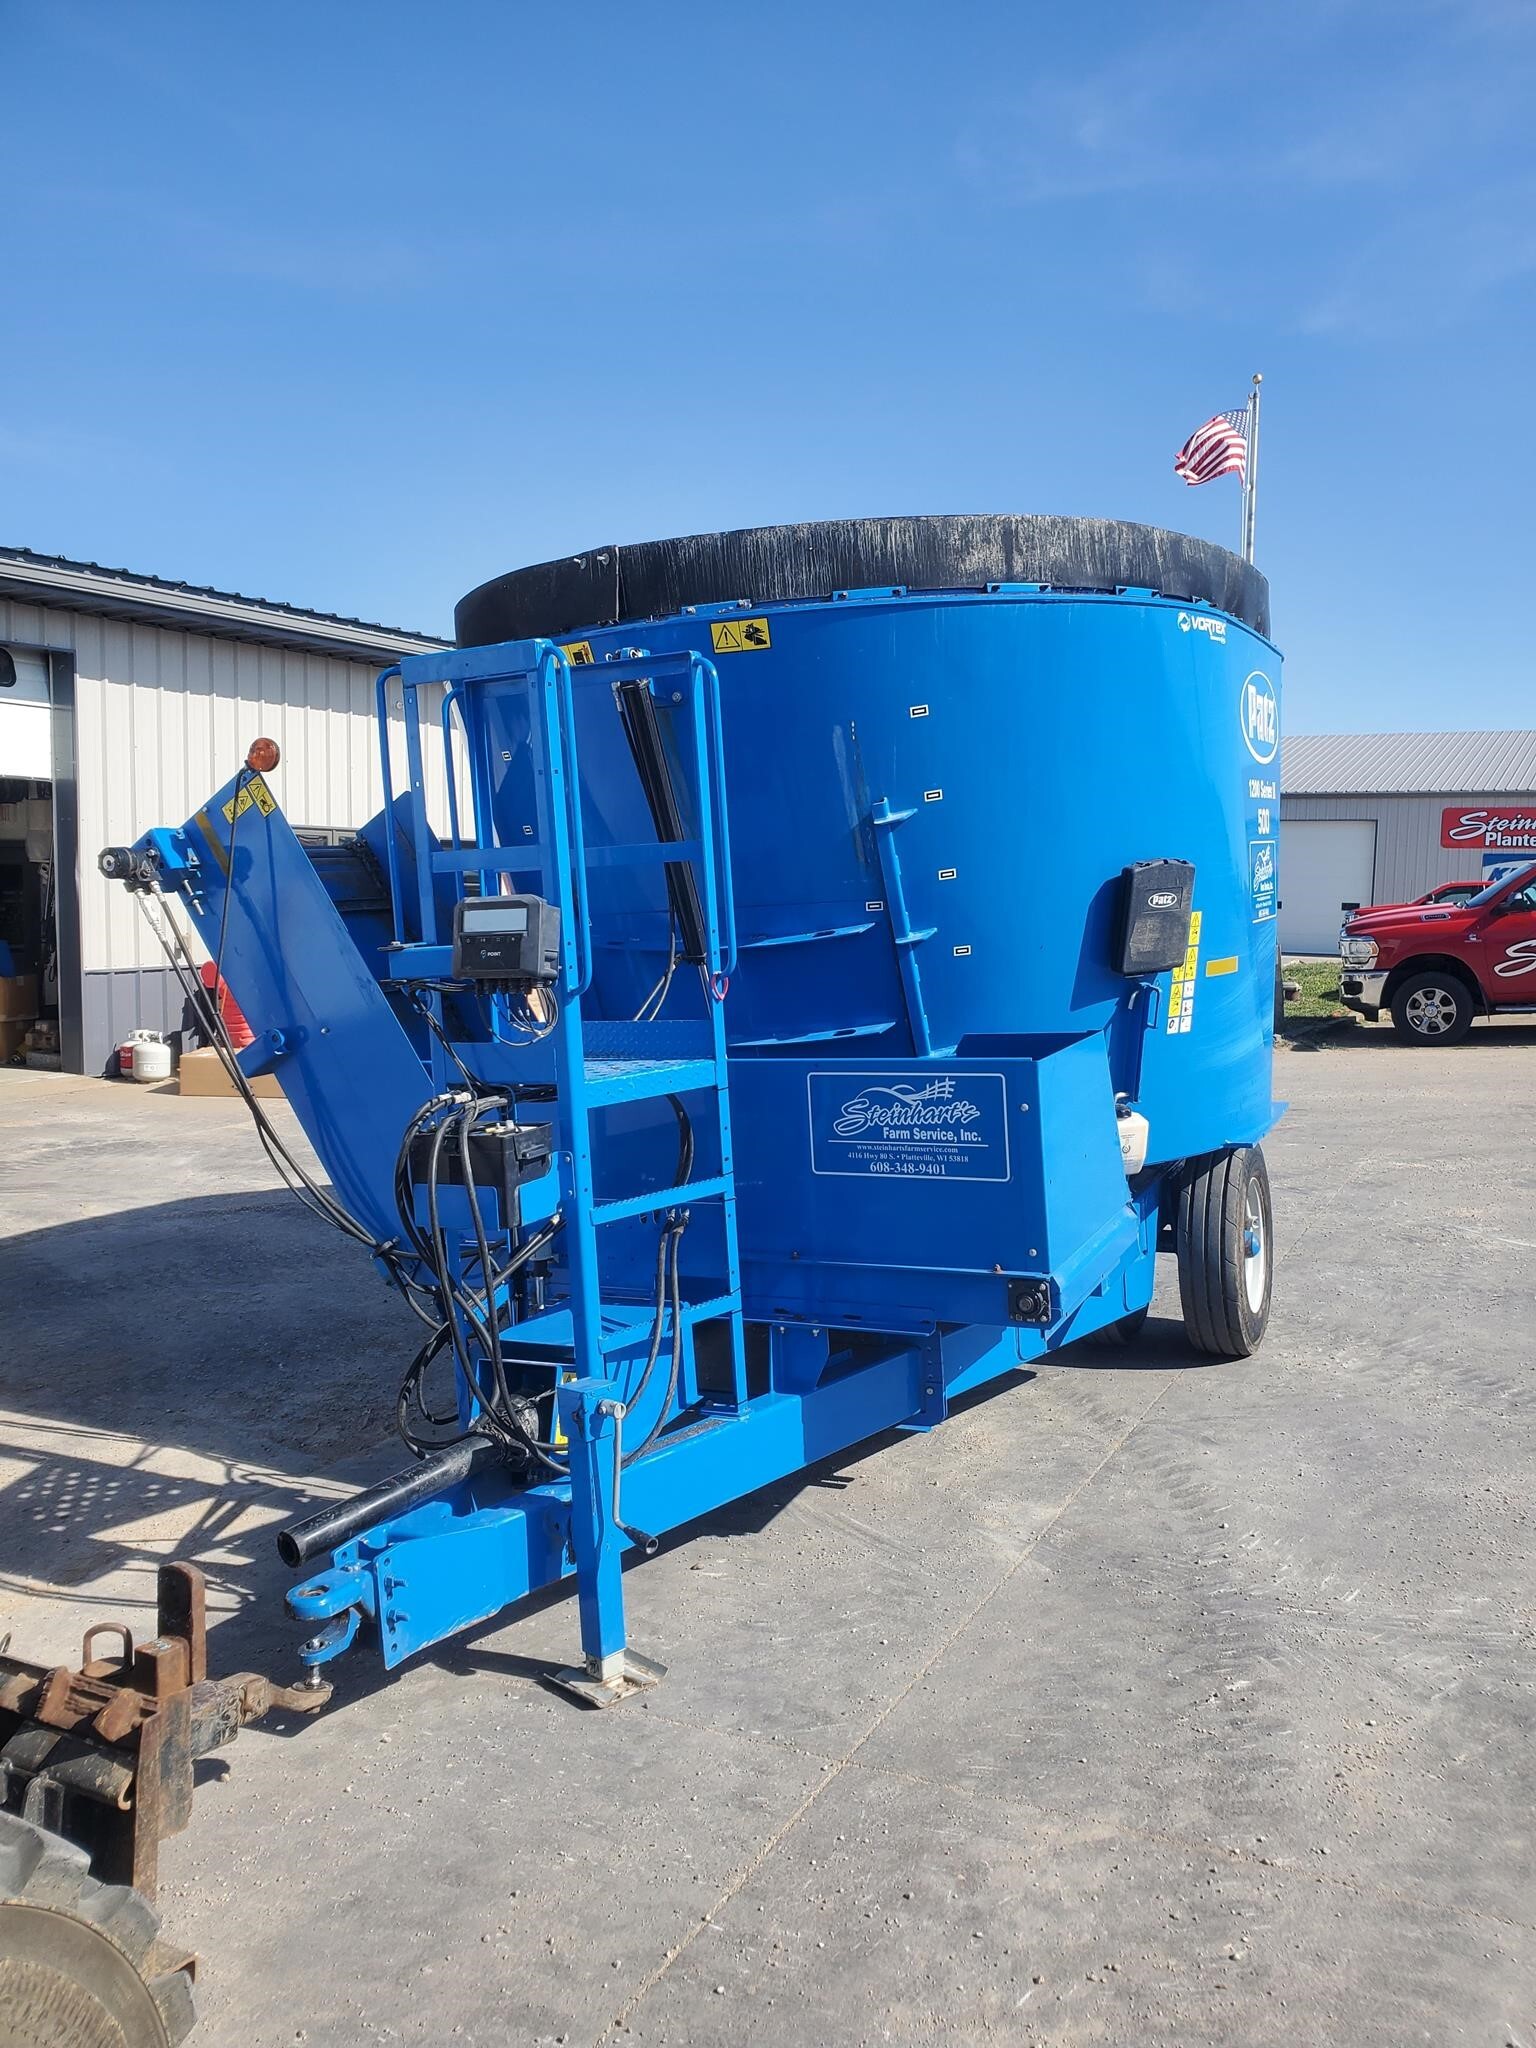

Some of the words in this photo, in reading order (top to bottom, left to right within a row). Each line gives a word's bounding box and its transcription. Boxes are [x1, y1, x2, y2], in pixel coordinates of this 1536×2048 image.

[1191, 616, 1226, 636] VORTEX
[1247, 684, 1275, 744] Patz
[1257, 808, 1270, 835] 500
[1449, 811, 1536, 840] Stein
[1485, 832, 1536, 847] Plante
[1152, 895, 1173, 905] Patz
[833, 1098, 981, 1136] Steinhart's
[883, 1127, 911, 1140] Farm
[913, 1128, 957, 1143] Service,
[960, 1129, 982, 1142] Inc.
[856, 1144, 958, 1154] www.steinhartsfarmservice.com
[864, 1152, 878, 1161] Hwy
[901, 1154, 936, 1162] Platteville,
[948, 1155, 969, 1163] 53818
[870, 1161, 946, 1175] 608-348-9401
